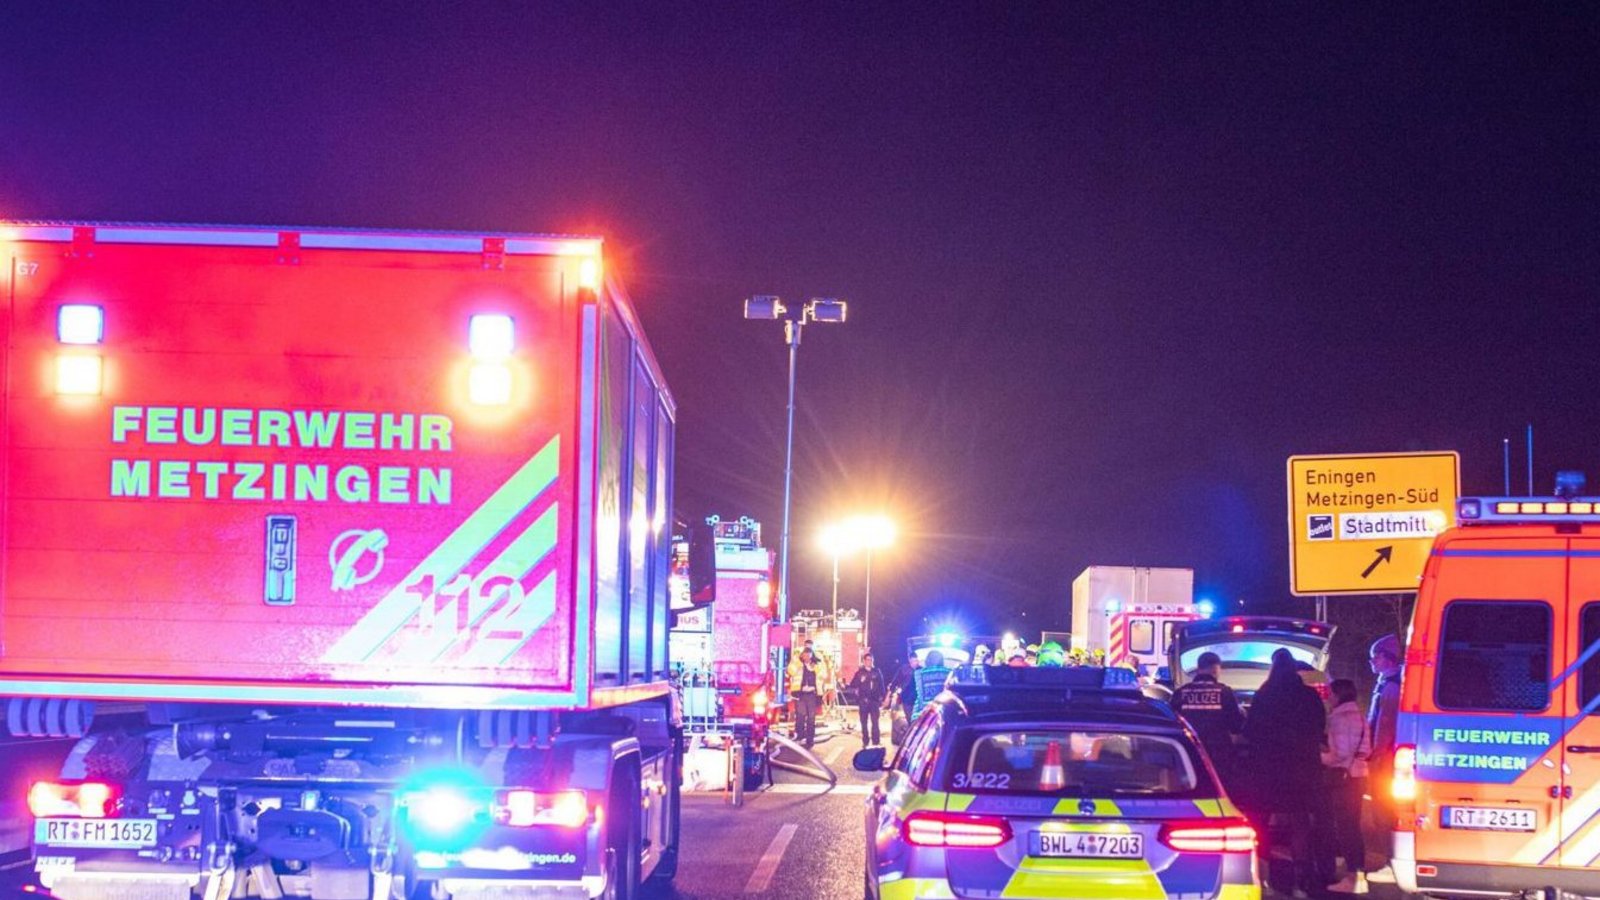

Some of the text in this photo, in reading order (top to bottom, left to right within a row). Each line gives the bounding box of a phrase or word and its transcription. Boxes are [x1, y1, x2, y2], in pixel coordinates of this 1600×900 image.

[111, 405, 454, 452] FEUERWEHR
[109, 459, 453, 505] METZINGEN
[1306, 469, 1376, 487] Eningen
[1306, 488, 1439, 508] Metzingen-Süd
[405, 574, 527, 640] 112
[1433, 728, 1551, 745] FEUERWEHR
[1417, 752, 1528, 771] METZINGEN
[1453, 809, 1531, 828] RT 2611
[48, 821, 153, 842] RT FM 1652
[1040, 835, 1072, 854] BWL
[1098, 836, 1140, 855] 7203
